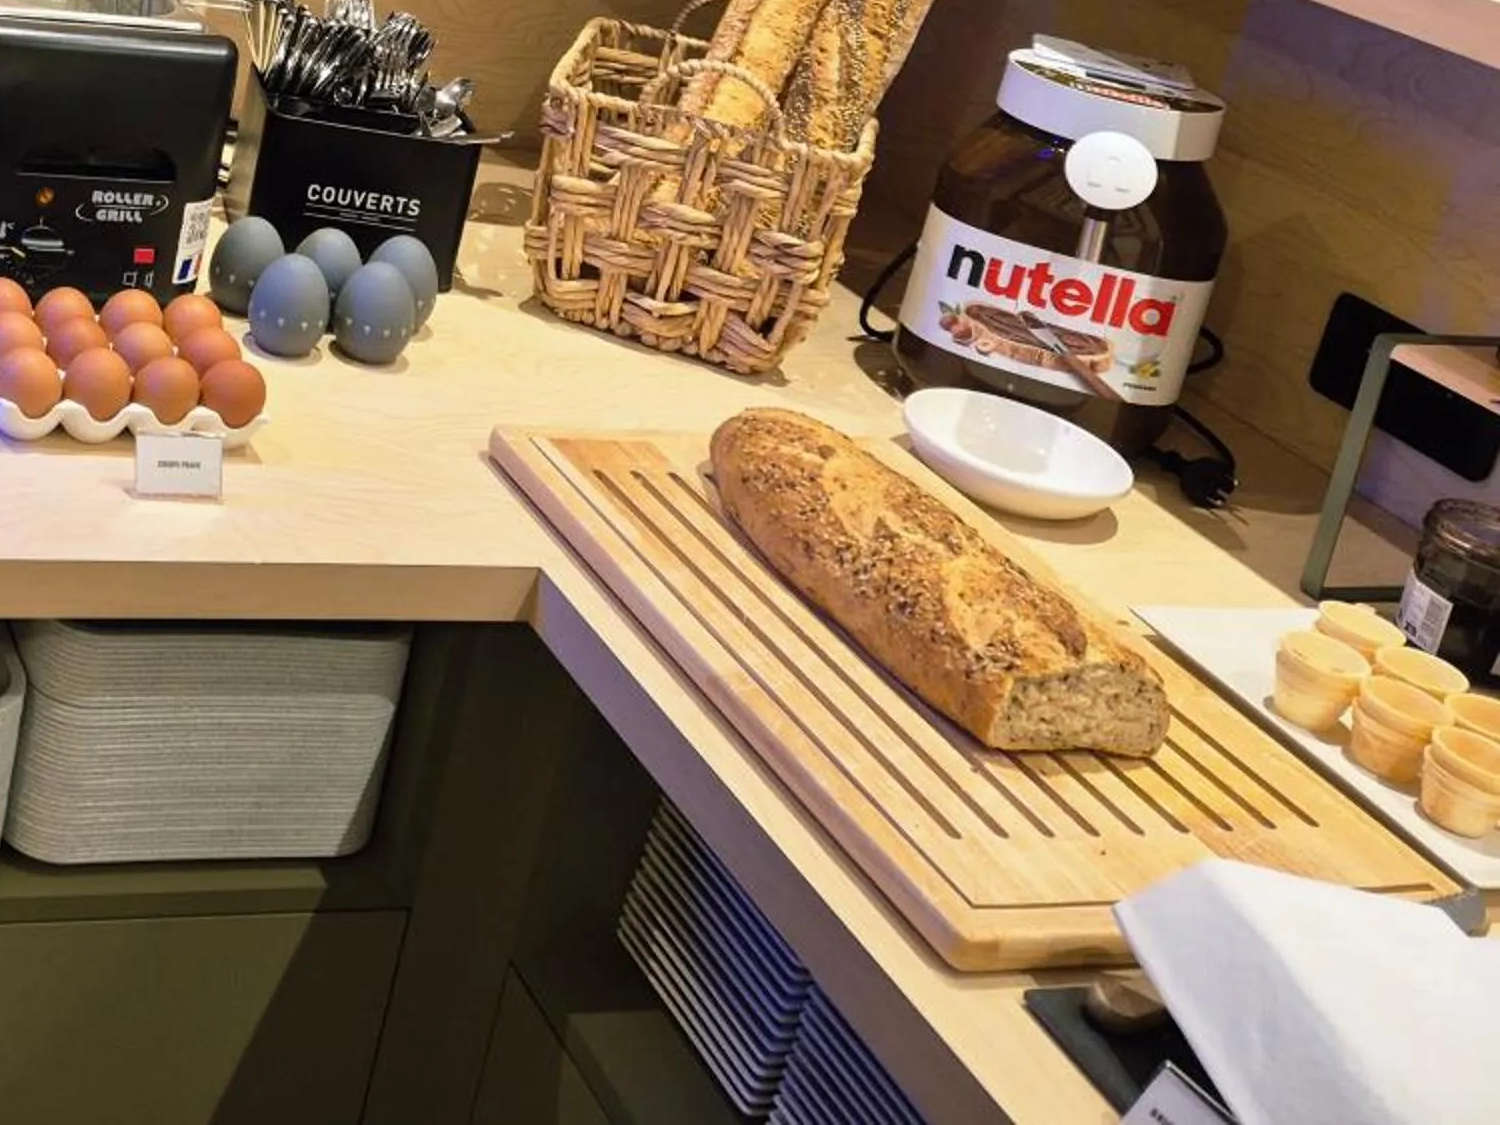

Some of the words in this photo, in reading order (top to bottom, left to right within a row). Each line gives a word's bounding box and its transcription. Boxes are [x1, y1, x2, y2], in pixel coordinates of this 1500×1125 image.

[92, 190, 153, 206] ROLLER
[307, 183, 421, 216] COUVERTS
[96, 209, 143, 223] GRILL
[948, 244, 1176, 338] nutella
